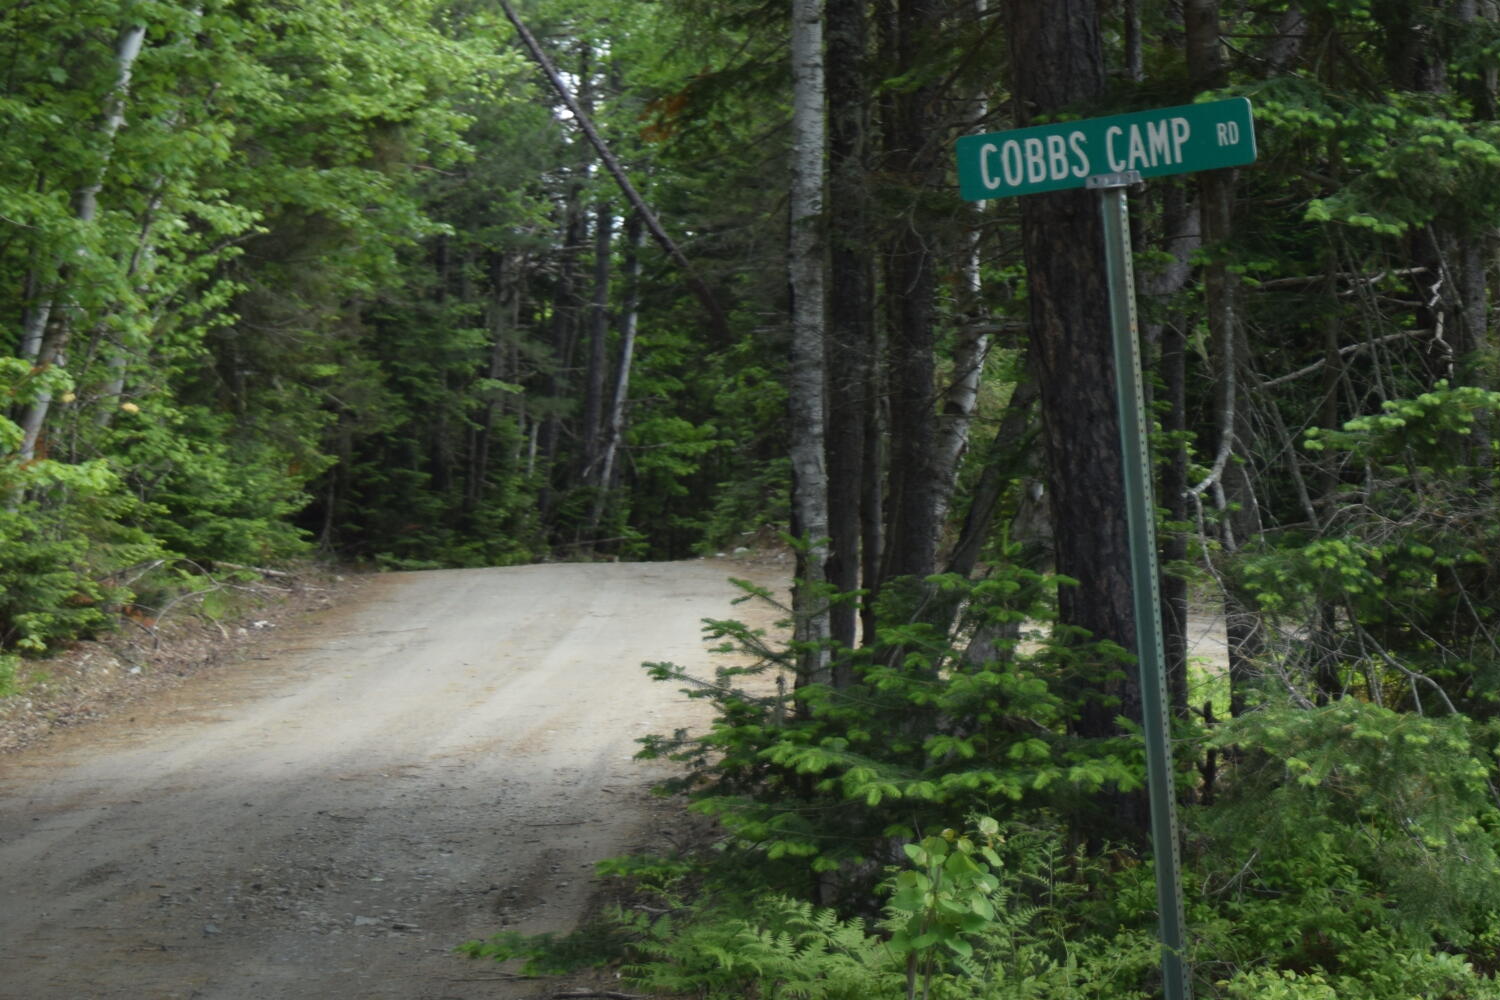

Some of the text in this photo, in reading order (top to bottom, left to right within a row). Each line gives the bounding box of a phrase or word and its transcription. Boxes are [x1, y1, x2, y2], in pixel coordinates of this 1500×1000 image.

[979, 117, 1240, 190] COBBS CAMP RD
